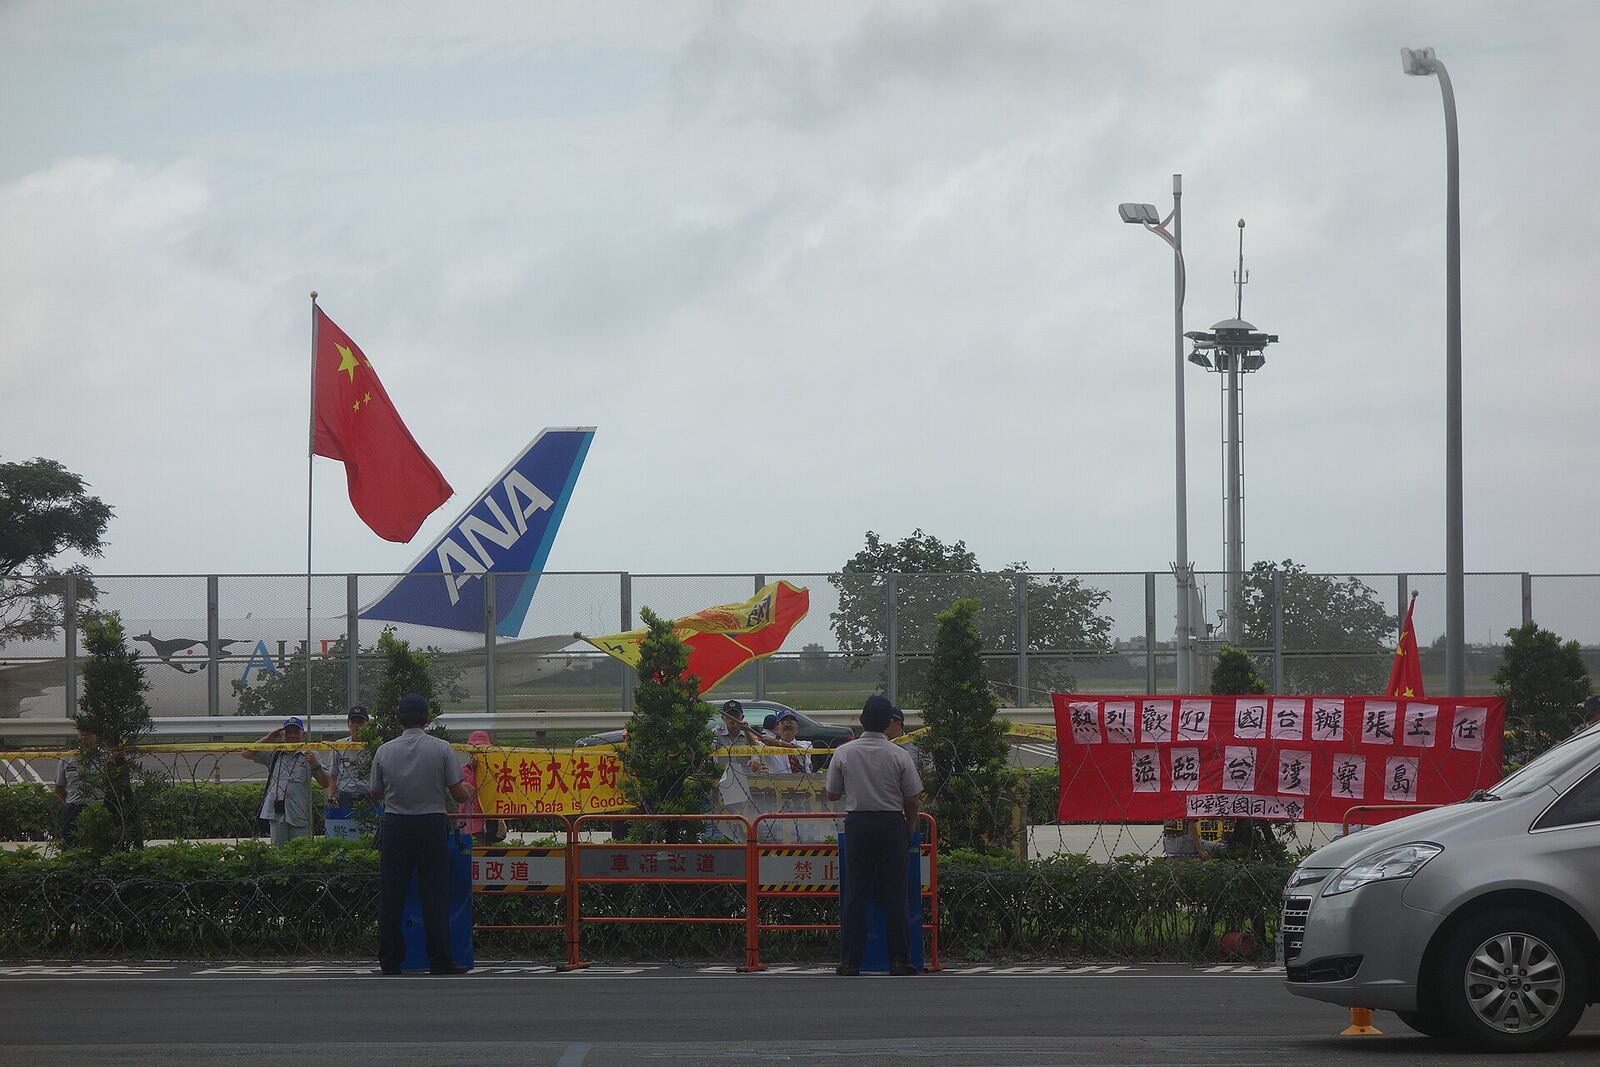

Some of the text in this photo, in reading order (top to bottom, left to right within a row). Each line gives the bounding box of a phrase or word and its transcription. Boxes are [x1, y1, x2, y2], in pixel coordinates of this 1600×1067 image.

[437, 469, 554, 607] ANA
[494, 755, 621, 794] 法輪大法好
[496, 794, 625, 814] Falun Dafa is Good
